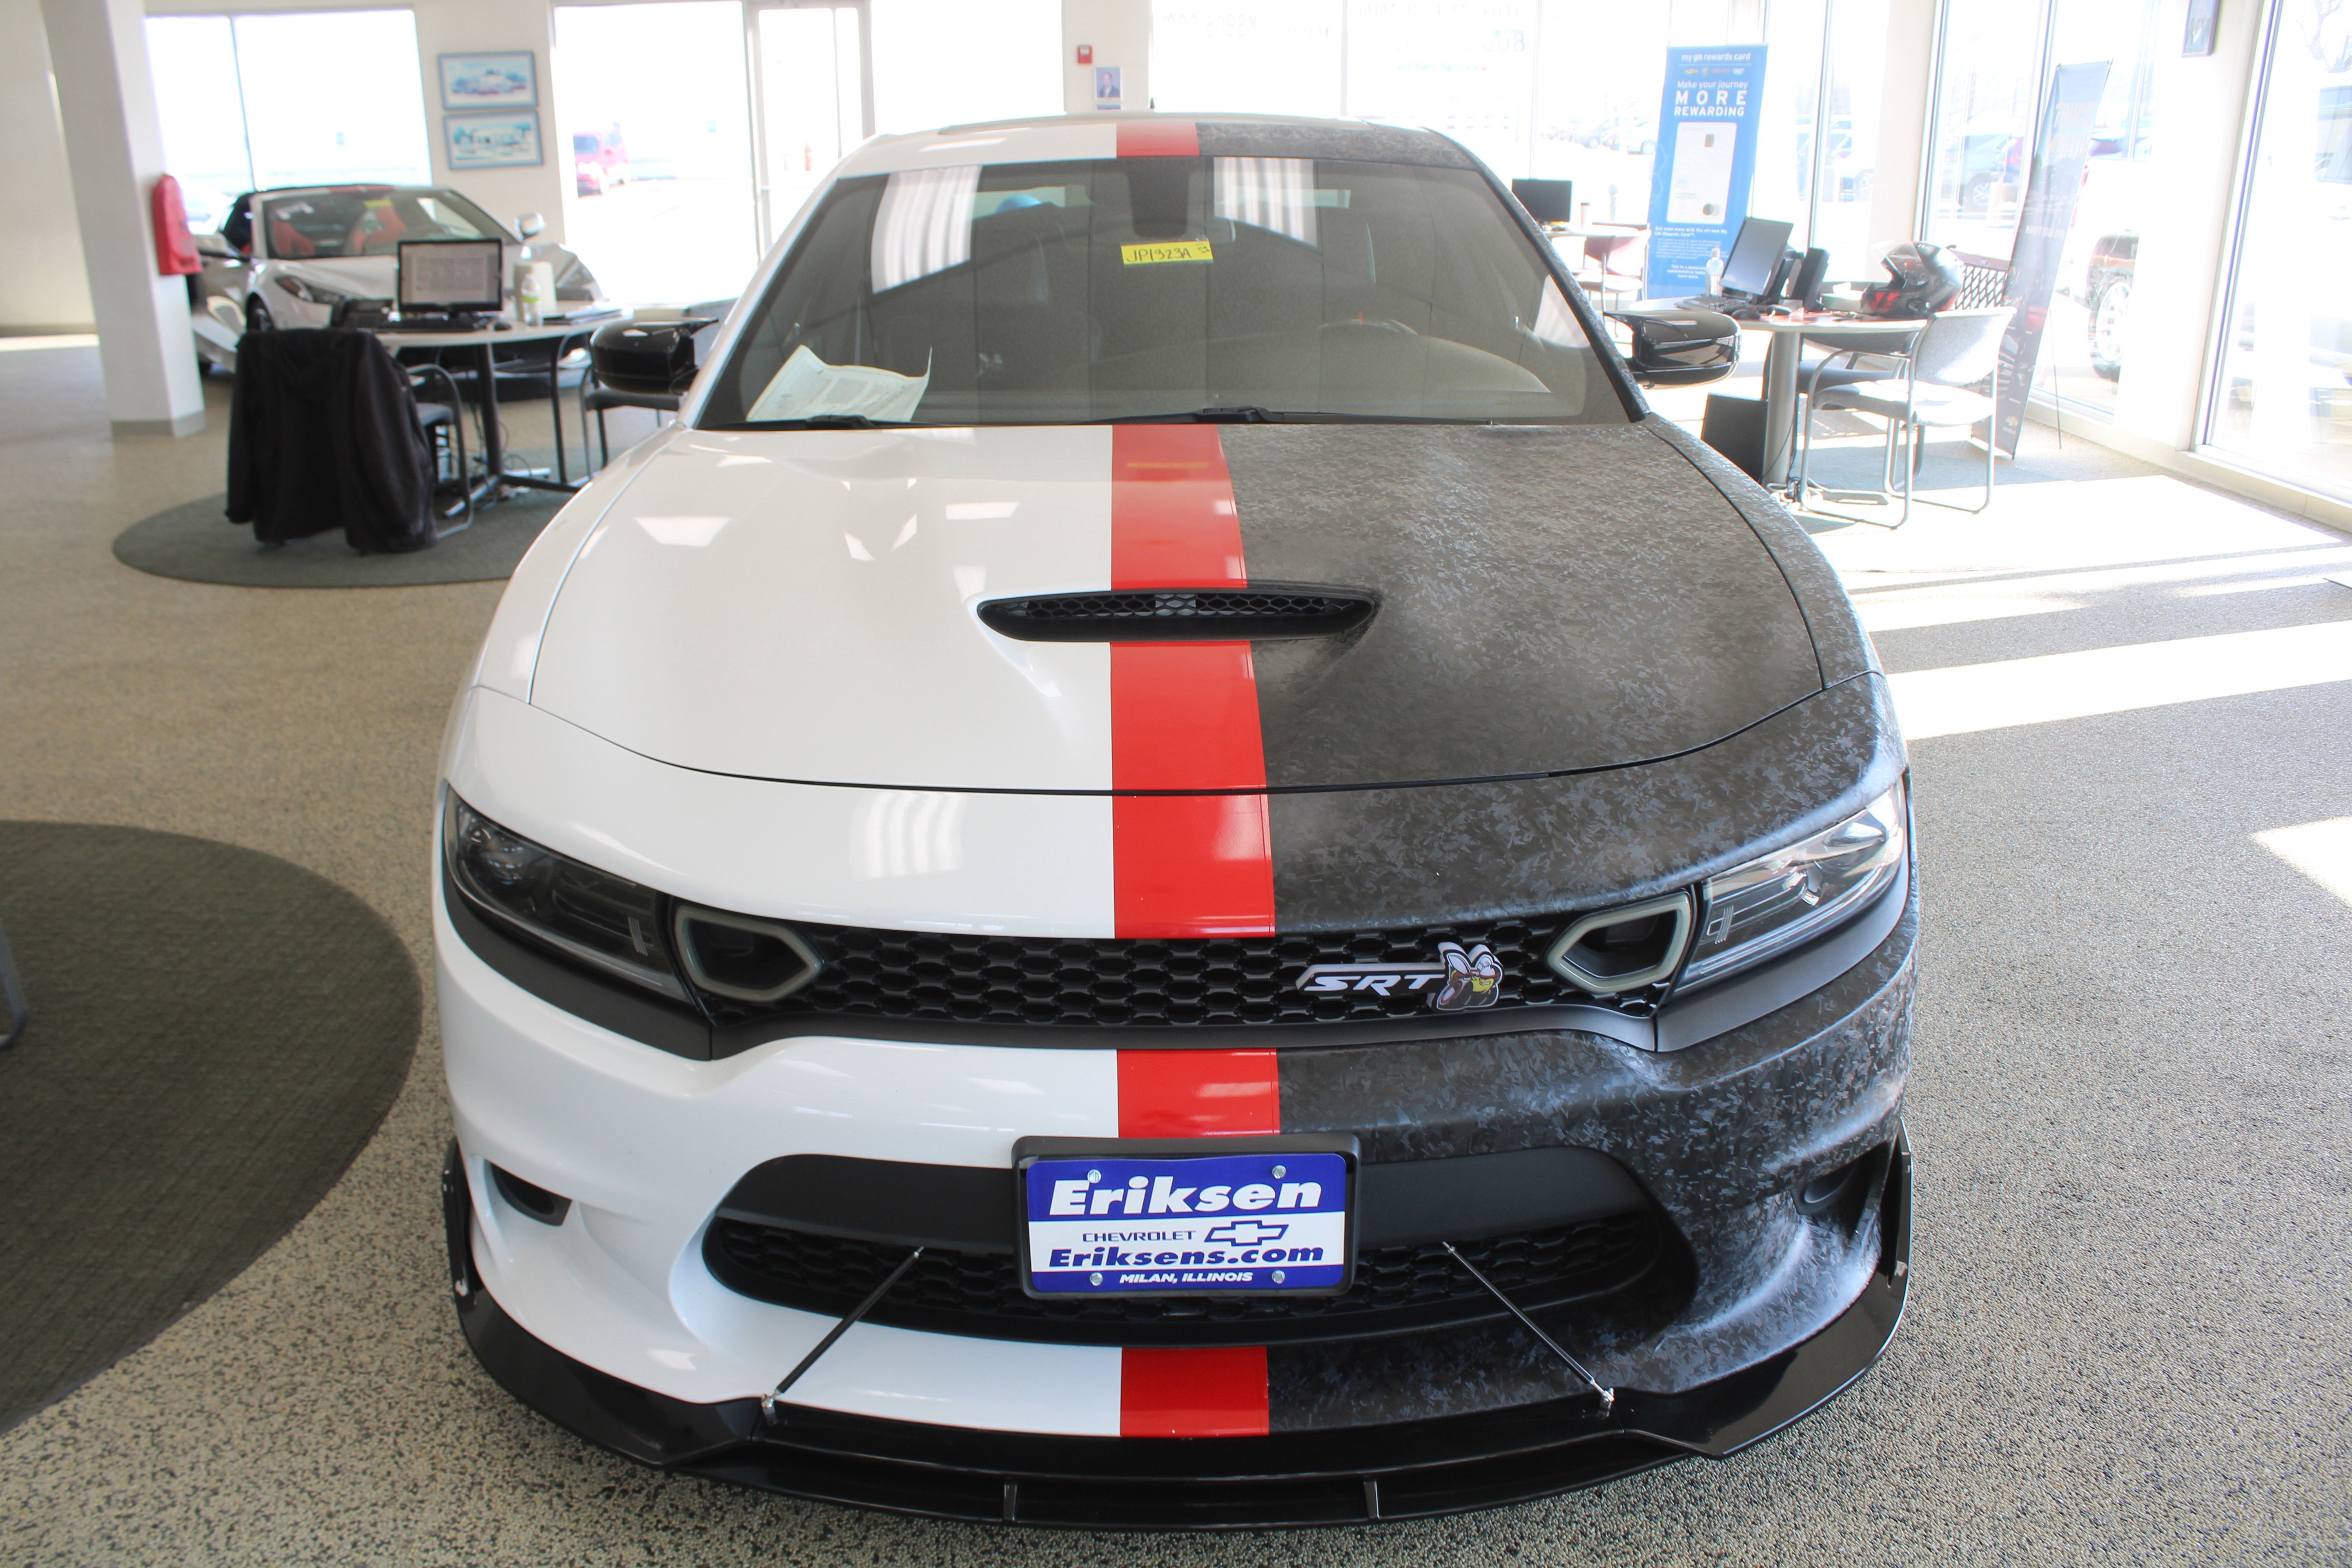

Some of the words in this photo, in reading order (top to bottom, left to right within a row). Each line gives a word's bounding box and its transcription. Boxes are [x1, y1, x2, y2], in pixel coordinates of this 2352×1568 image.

[1717, 80, 1748, 89] journey
[1675, 90, 1747, 105] MORE
[1674, 106, 1744, 116] REWARDING
[1126, 247, 1192, 262] JP1323A
[1304, 974, 1446, 996] SRT
[1049, 1176, 1322, 1216] Eriksen
[1082, 1230, 1196, 1242] CHEVROLET
[1049, 1247, 1323, 1267] Eriksens.com
[1119, 1273, 1178, 1284] MILAN,
[1182, 1272, 1253, 1283] ILLINOIS
